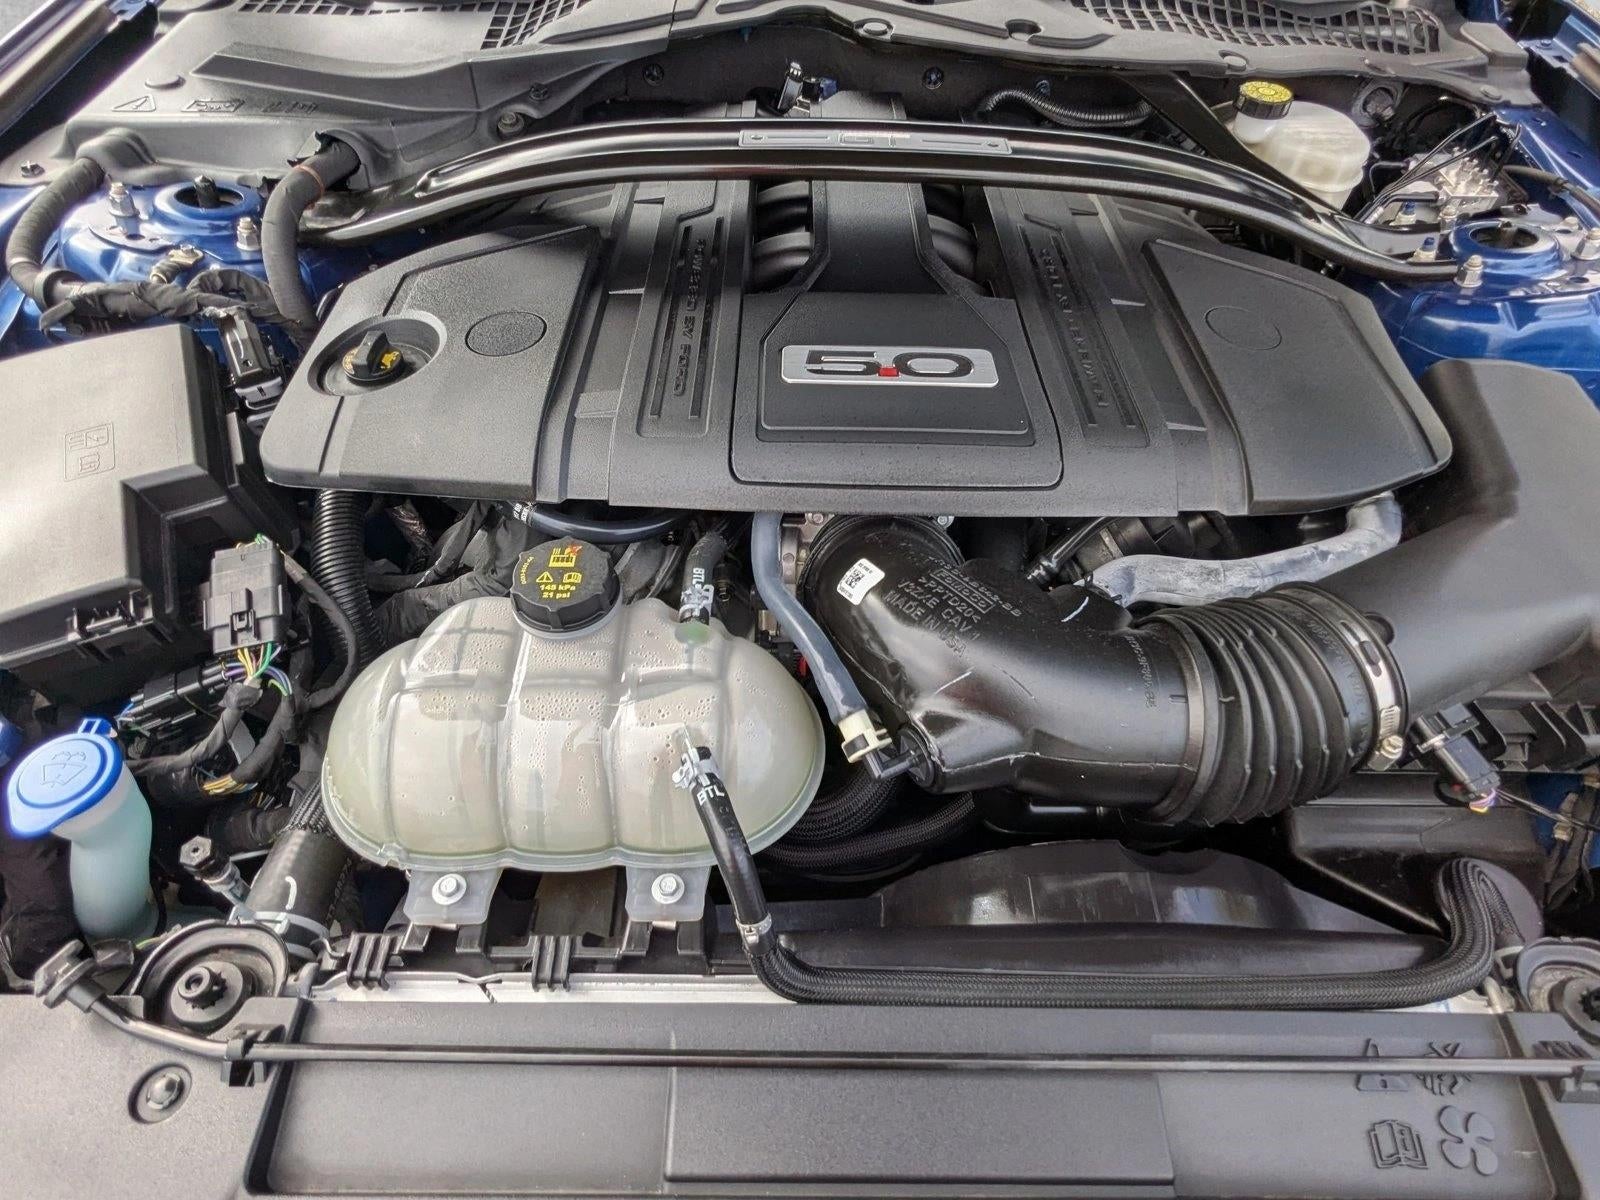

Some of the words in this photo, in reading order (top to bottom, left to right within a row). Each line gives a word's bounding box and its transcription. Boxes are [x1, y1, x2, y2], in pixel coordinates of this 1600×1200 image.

[805, 349, 975, 378] 5.0
[540, 584, 556, 592] 145
[558, 583, 577, 592] kPa
[883, 589, 926, 621] MADE
[924, 614, 941, 631] IN
[940, 626, 968, 658] USA
[696, 785, 725, 806] BTL
